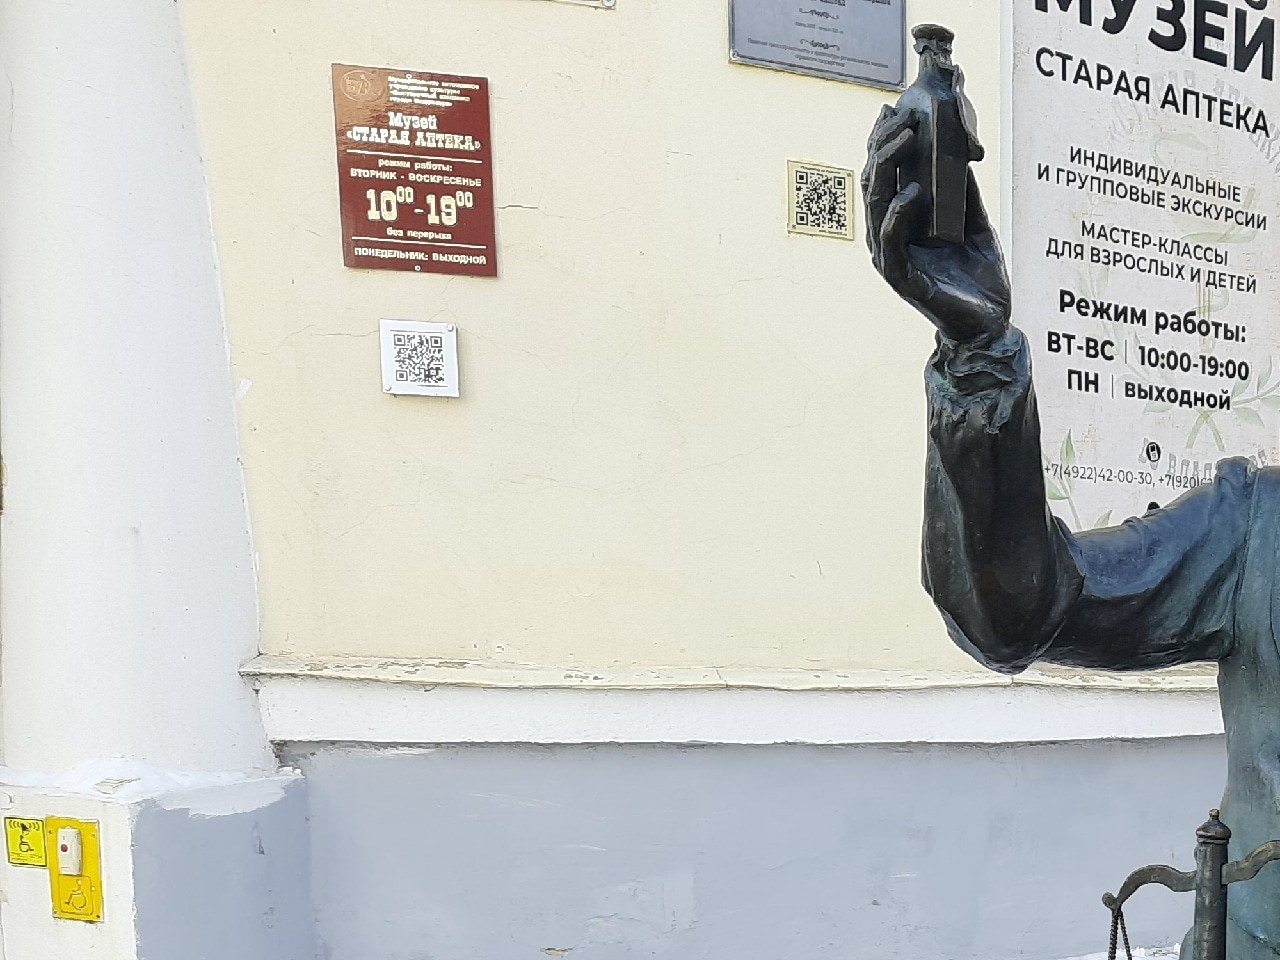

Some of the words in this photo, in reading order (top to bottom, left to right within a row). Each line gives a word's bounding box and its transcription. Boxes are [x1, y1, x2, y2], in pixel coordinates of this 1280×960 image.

[1035, 47, 1150, 104] СТАРАЯ
[1160, 84, 1270, 138] АПТЕКА
[388, 112, 437, 130] Музей
[350, 168, 397, 180] ВТОРНИК
[409, 173, 482, 187] ВОСКРЕСЕНЬЕ
[378, 158, 411, 169] режим
[415, 161, 452, 172] работы:
[1070, 146, 1241, 202] ИНДИВИДУАЛЬНЫЕ
[1037, 163, 1050, 181] И
[1056, 168, 1165, 209] ГРУППОВЫЕ
[1170, 195, 1267, 230] ЭКСКУРСИИ
[432, 252, 487, 265] ВЫХОДНОЙ
[1046, 238, 1083, 260] ДЛЯ
[1090, 246, 1185, 281] ВЗРОСЛЫХ
[1190, 267, 1200, 283] И
[1205, 270, 1257, 293] ДЕТЕЙ
[1082, 220, 1228, 266] МАСТЕР-КЛАССЫ
[1059, 289, 1147, 326] Режим
[1155, 310, 1247, 342] работы:
[1047, 331, 1115, 361] ВТ-ВС
[1139, 345, 1249, 380] 10:00-19:00
[1067, 369, 1099, 393] ПН
[1124, 382, 1231, 410] выходной
